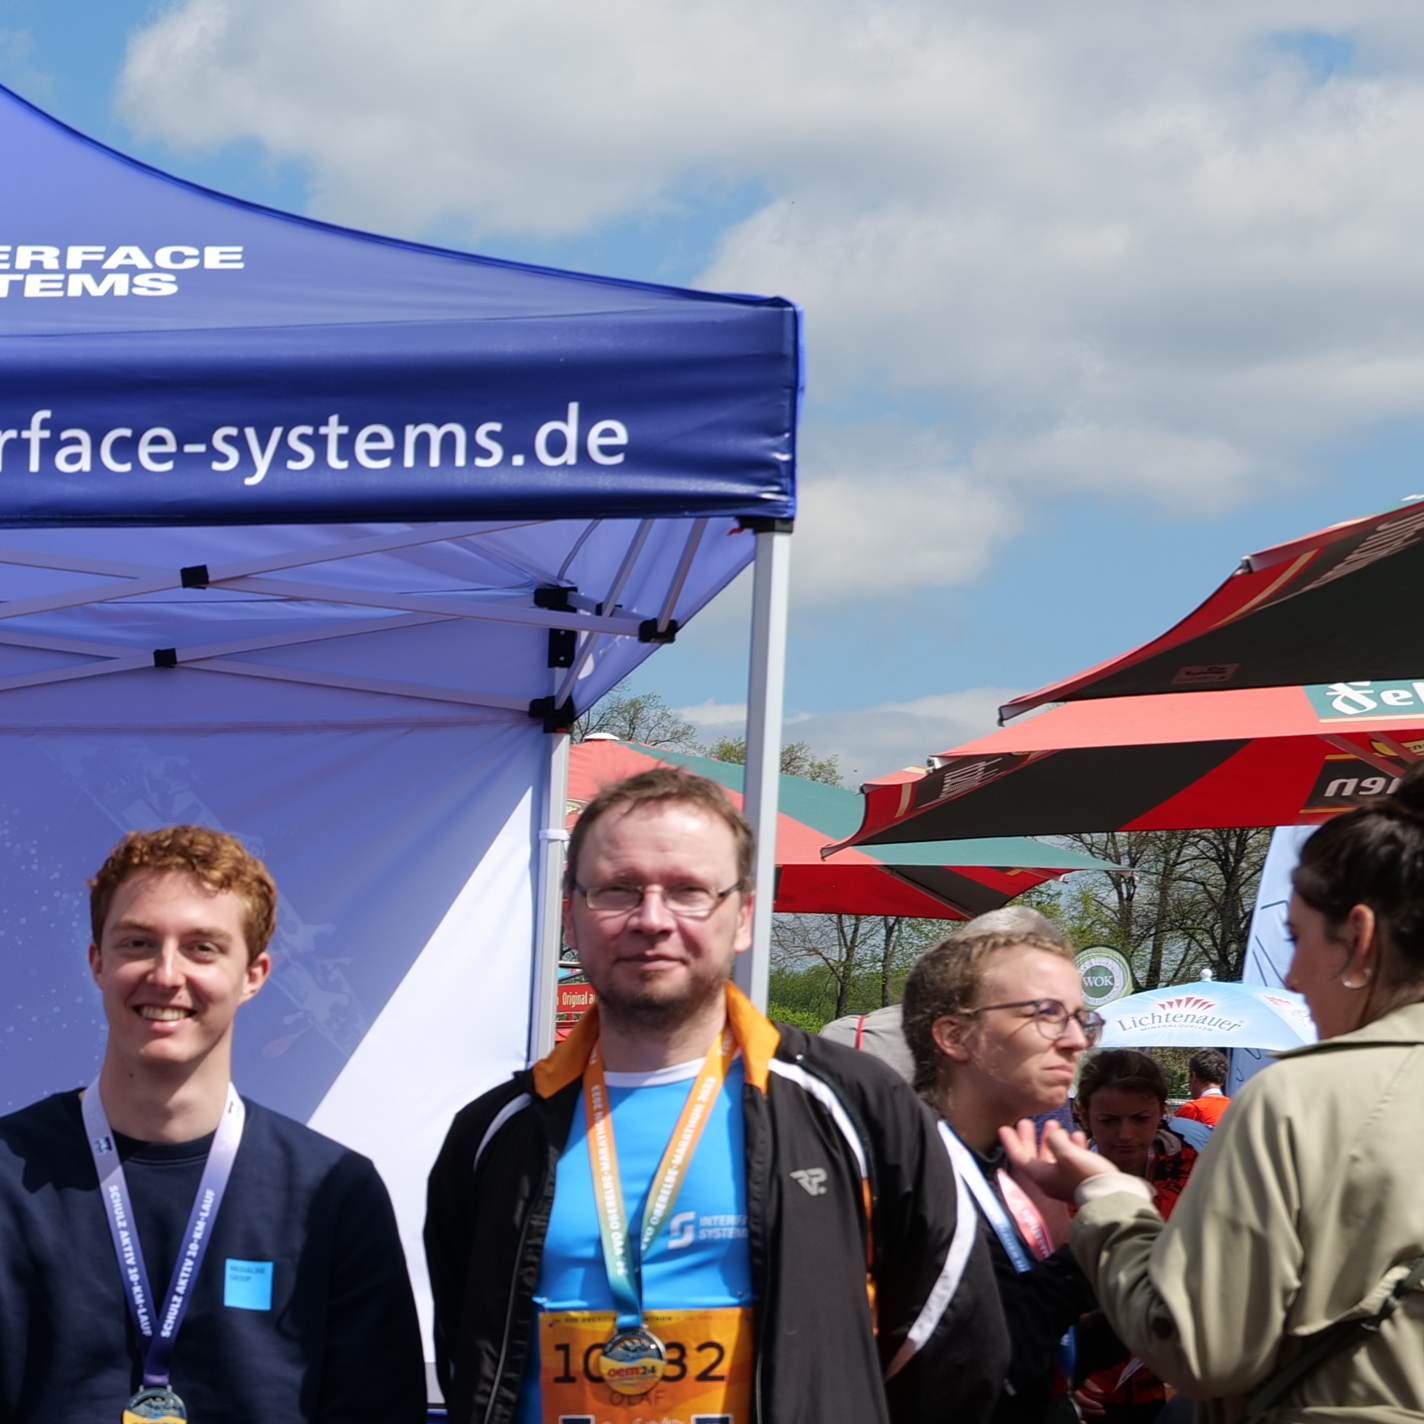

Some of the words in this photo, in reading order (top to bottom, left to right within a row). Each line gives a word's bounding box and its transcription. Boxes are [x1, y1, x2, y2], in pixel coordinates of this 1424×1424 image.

[1082, 975, 1114, 988] WOK
[1116, 1012, 1241, 1032] Lichtenauer
[650, 1104, 705, 1226] OBERELBE-MARATHON
[109, 1185, 127, 1228] SCHULZ
[119, 1228, 136, 1266] AKTIV
[160, 1294, 183, 1338] SCHULZ
[174, 1257, 195, 1295] AKTIV
[607, 1366, 657, 1378] oem24
